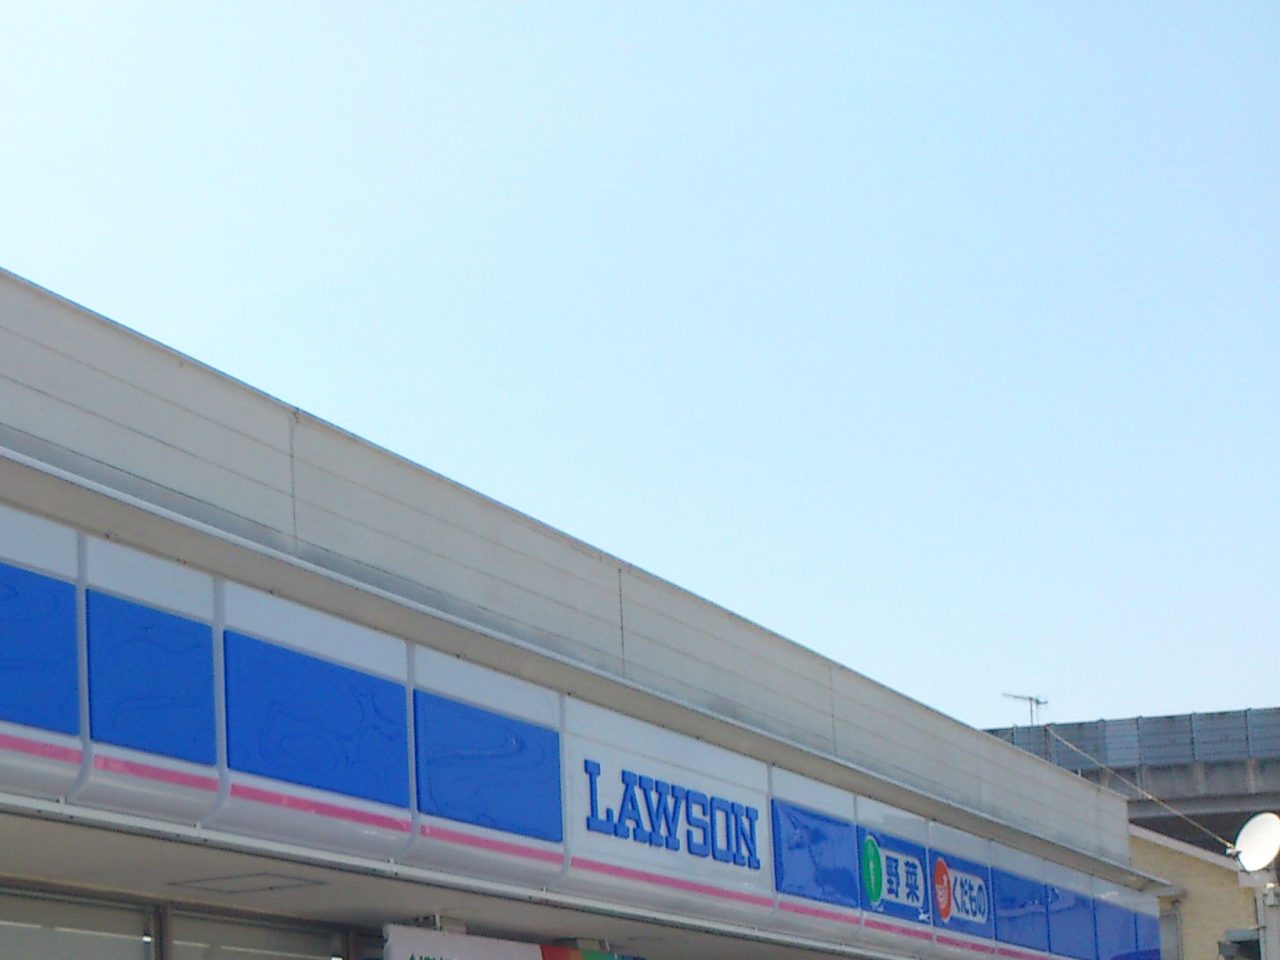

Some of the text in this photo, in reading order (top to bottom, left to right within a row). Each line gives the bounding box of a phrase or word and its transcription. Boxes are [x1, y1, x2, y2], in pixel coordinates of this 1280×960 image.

[584, 759, 761, 869] LAWSON
[885, 855, 920, 903] 野菜
[952, 877, 987, 919] くだもの
